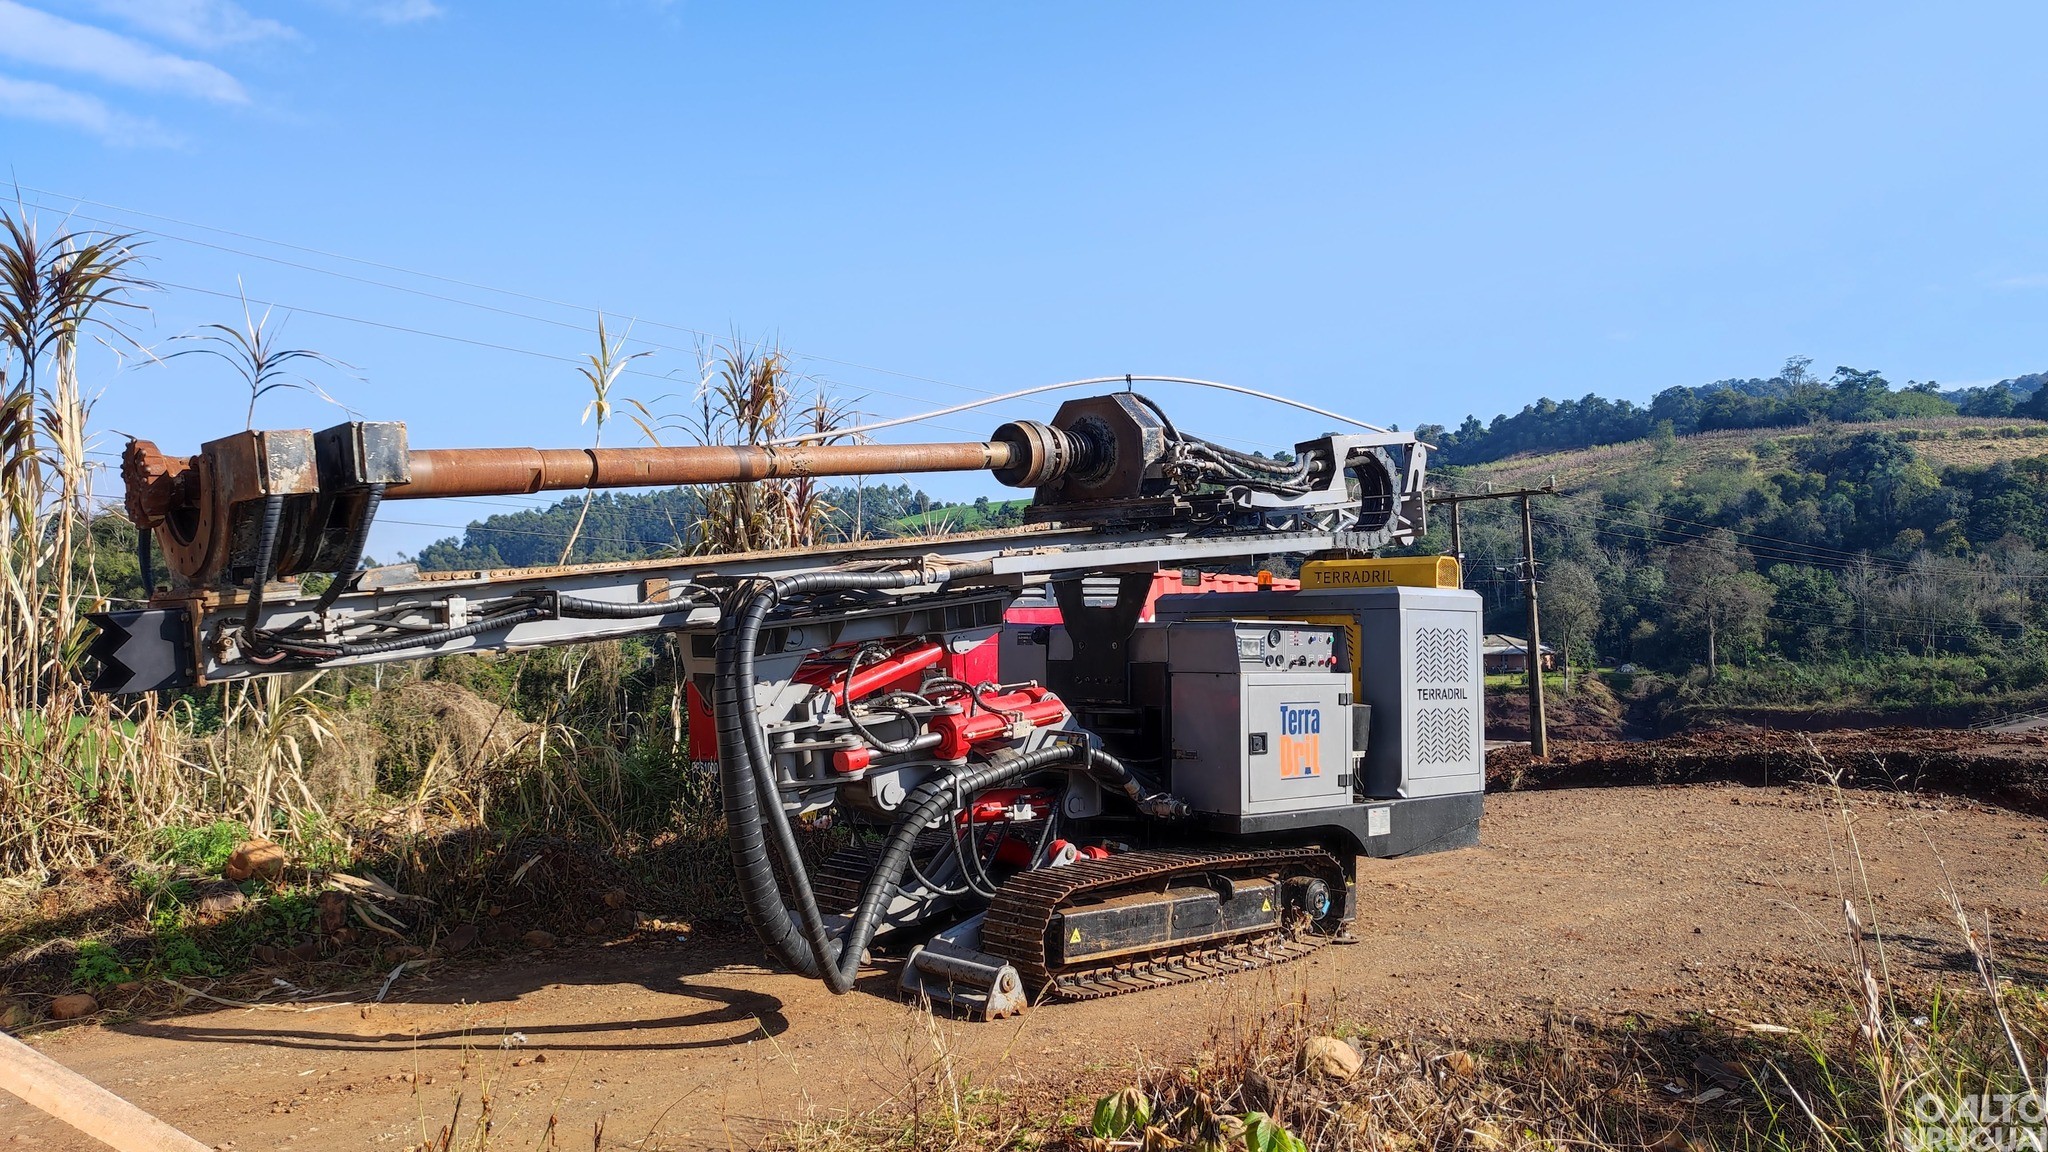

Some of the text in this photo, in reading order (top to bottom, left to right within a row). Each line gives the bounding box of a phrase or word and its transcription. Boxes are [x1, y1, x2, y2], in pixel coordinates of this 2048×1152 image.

[1314, 570, 1394, 583] TERRADRIL
[1417, 688, 1468, 700] TERRADRIL
[1280, 706, 1320, 735] Terra
[1280, 734, 1320, 776] Dril
